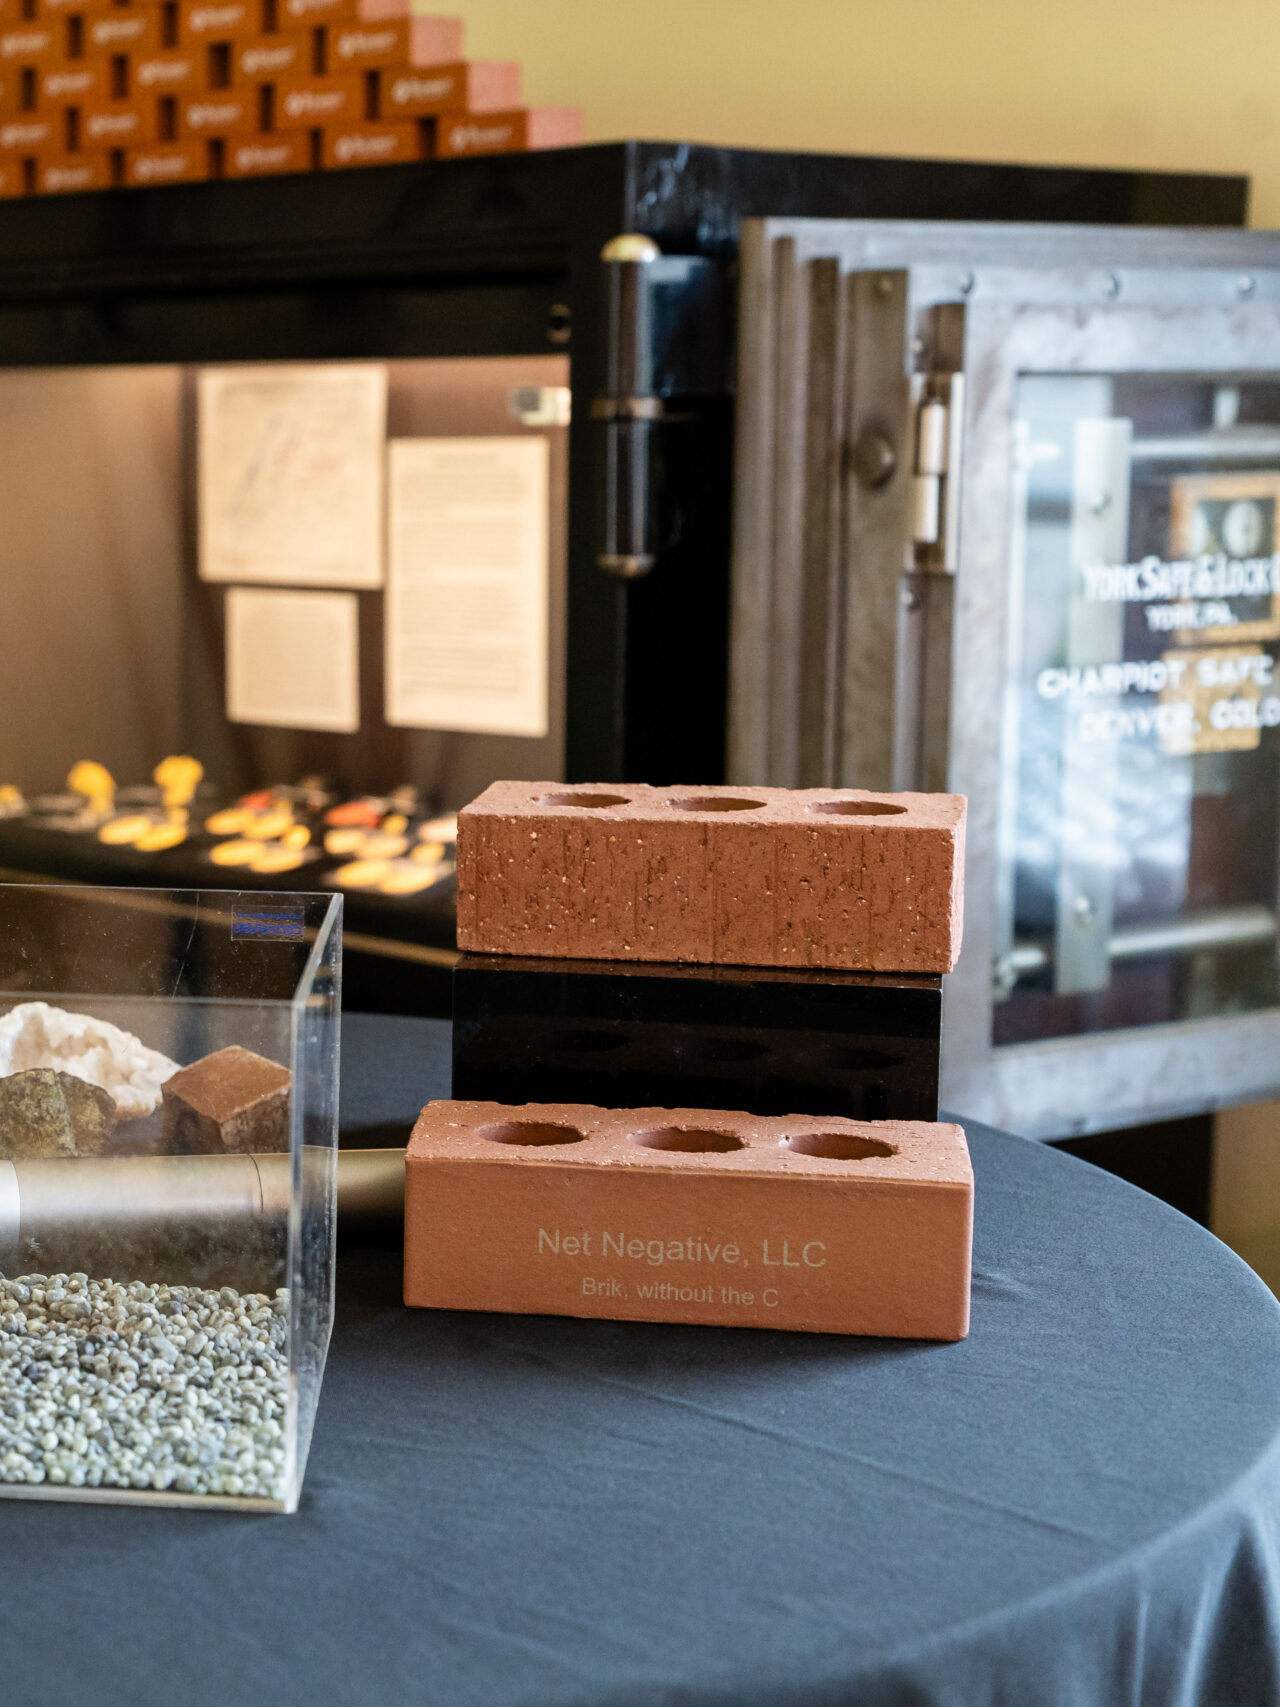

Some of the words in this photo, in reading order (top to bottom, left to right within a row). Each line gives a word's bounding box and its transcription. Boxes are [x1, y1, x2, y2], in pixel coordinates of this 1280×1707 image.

[1037, 660, 1186, 698] CHARPIOT
[1196, 655, 1274, 688] SAFE
[537, 1228, 592, 1256] Net
[602, 1231, 750, 1268] Negative,
[762, 1239, 827, 1268] LLC
[636, 1281, 714, 1303] without
[720, 1286, 756, 1306] the
[761, 1288, 780, 1308] C
